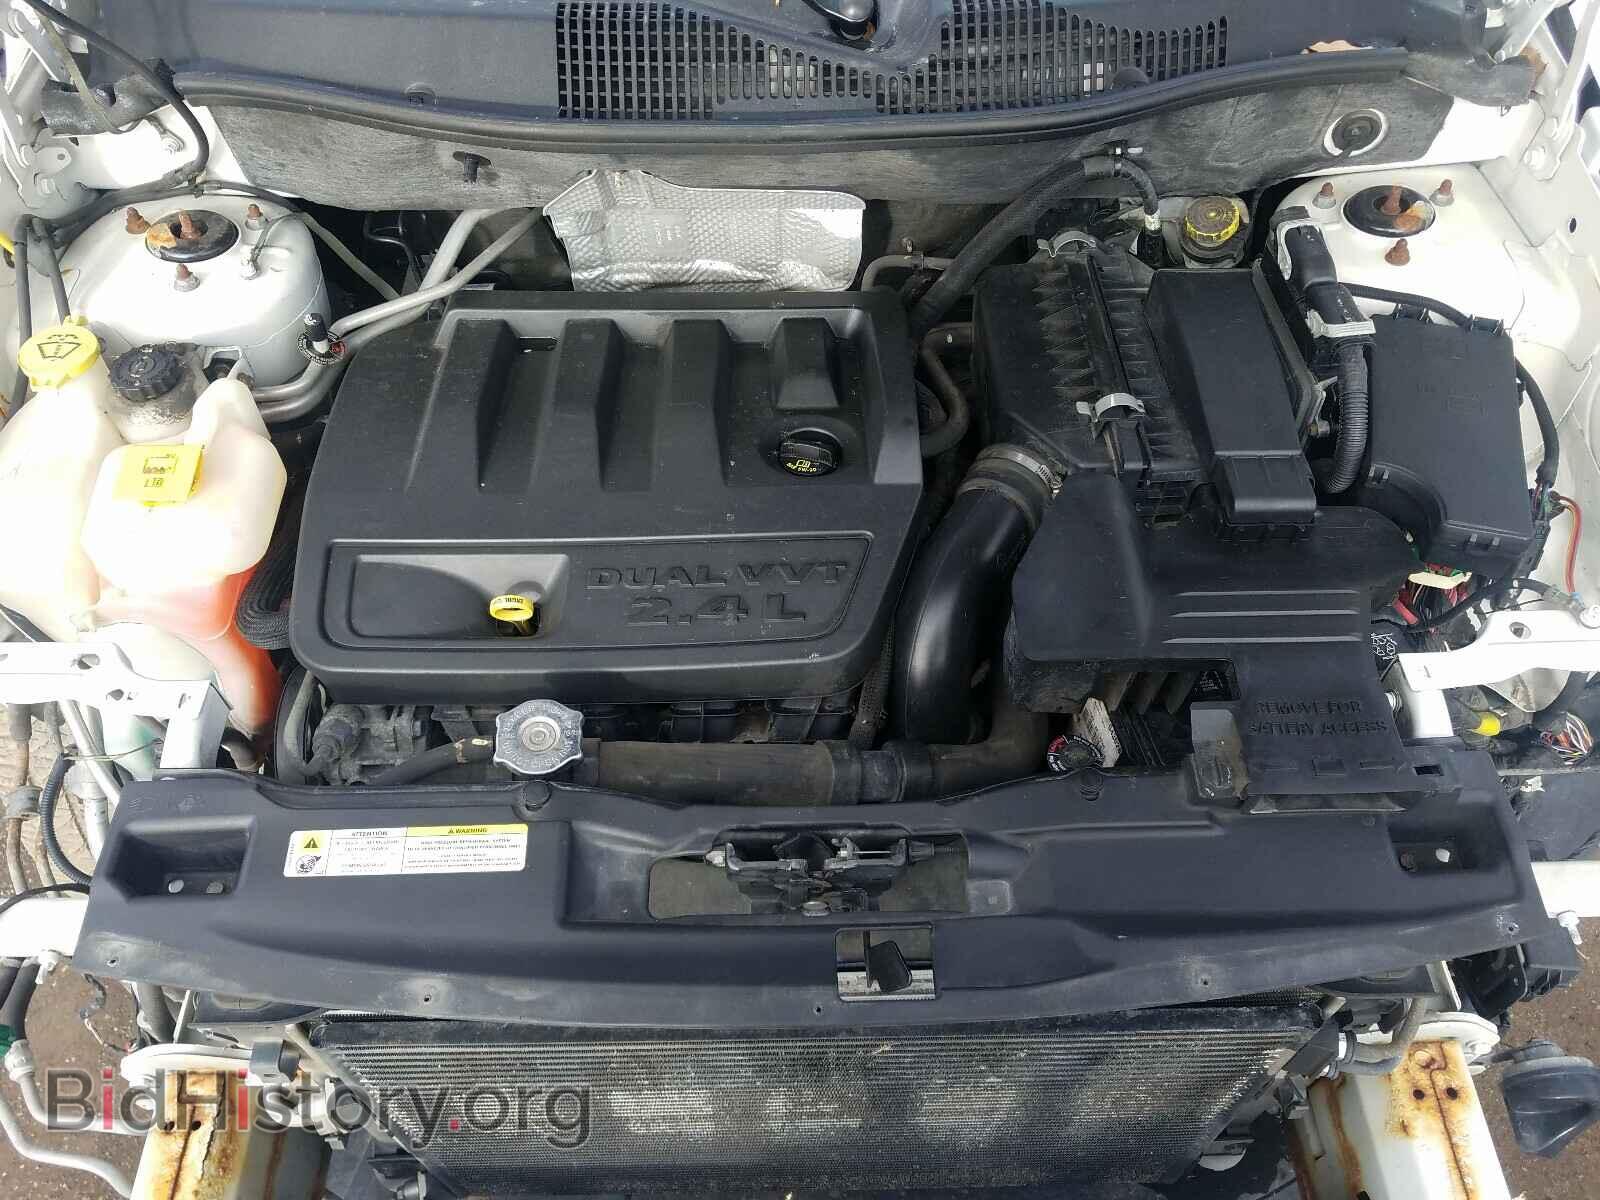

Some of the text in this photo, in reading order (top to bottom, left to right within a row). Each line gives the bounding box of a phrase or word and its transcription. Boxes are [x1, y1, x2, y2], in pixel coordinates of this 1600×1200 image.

[585, 562, 848, 590] DUAL VVT
[1255, 701, 1362, 715] REMOVE FOR
[1320, 719, 1388, 735] ACCESS
